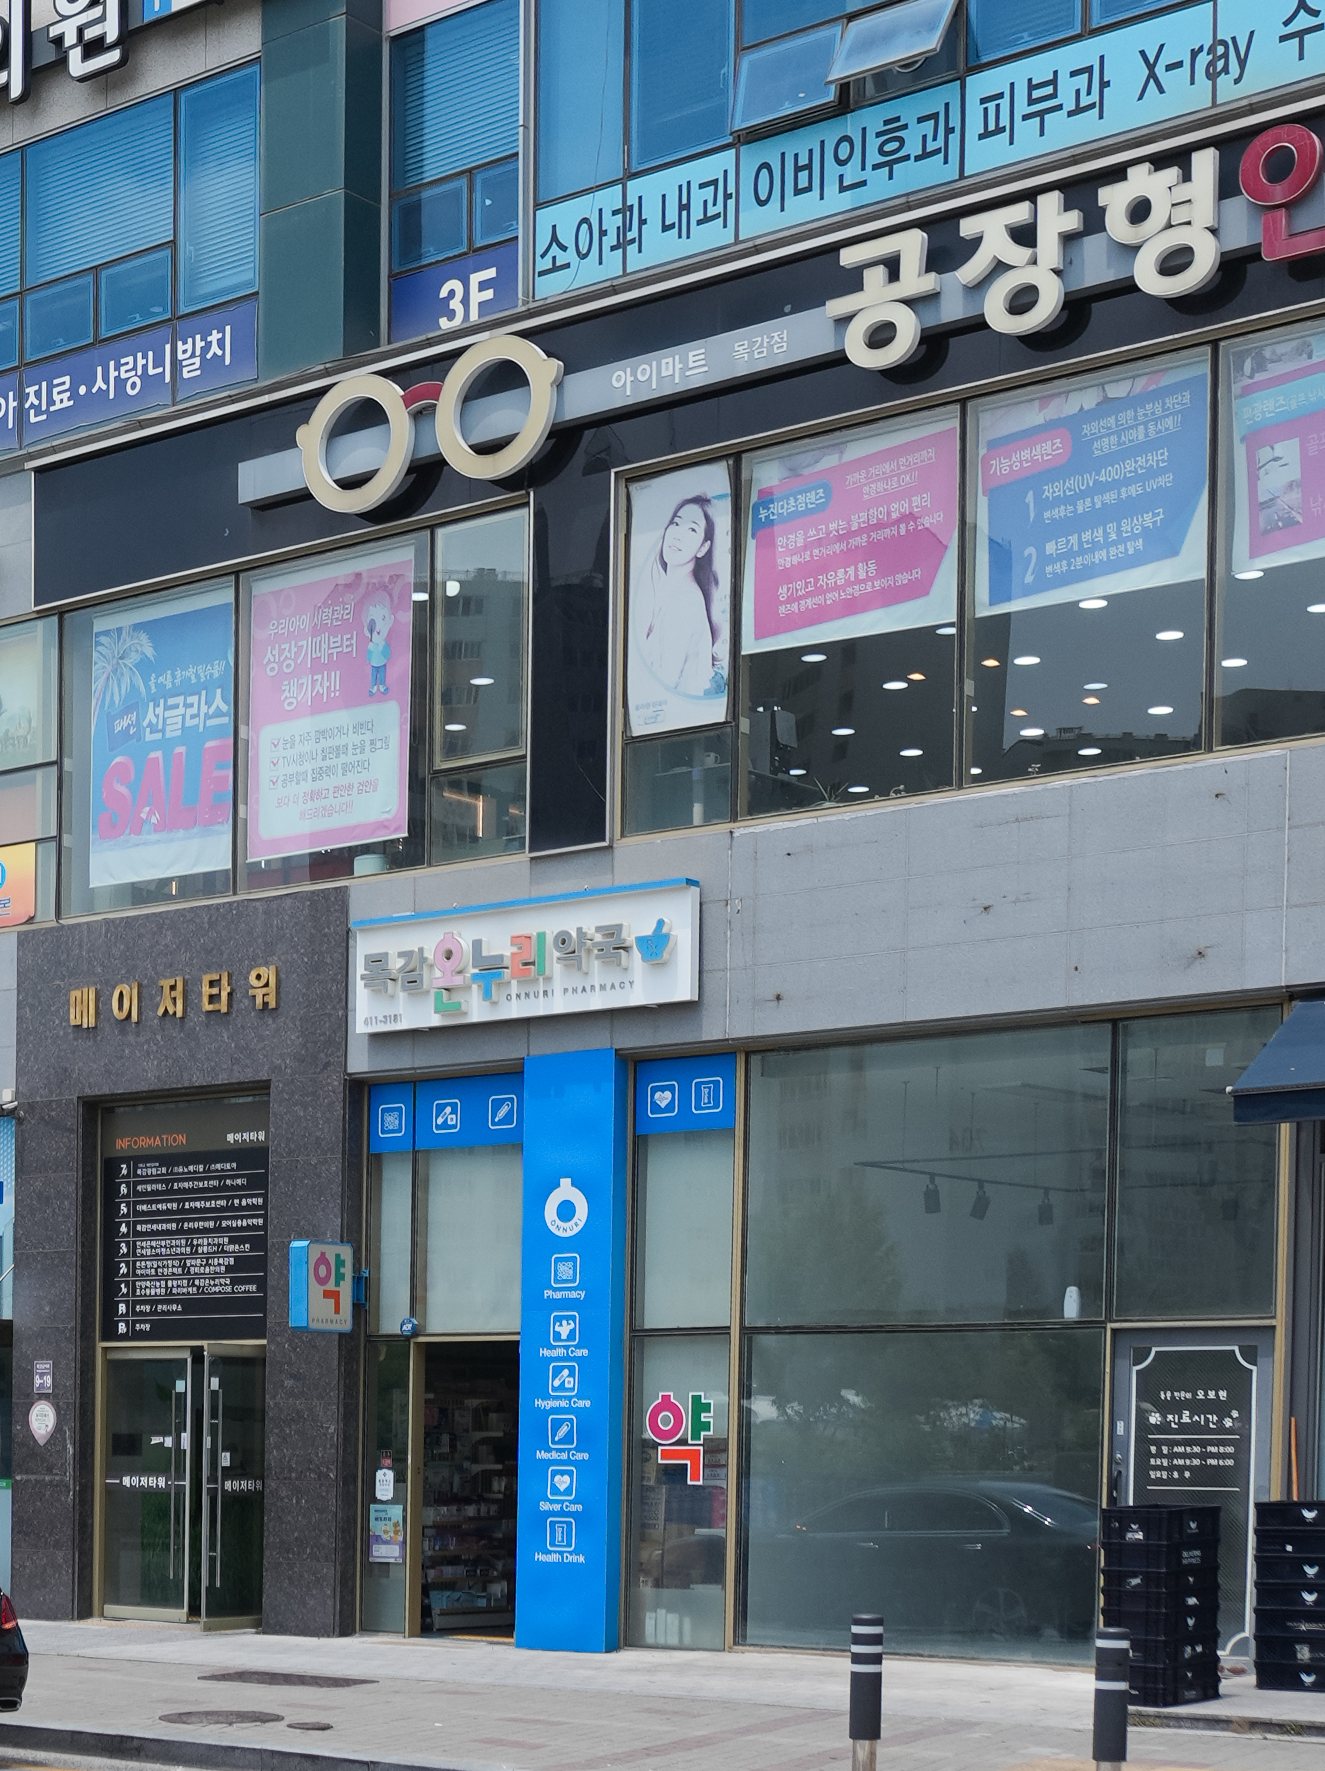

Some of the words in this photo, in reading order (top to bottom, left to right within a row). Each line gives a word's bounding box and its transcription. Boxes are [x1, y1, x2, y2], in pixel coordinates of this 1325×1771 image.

[536, 194, 648, 278] 소아과
[660, 168, 733, 234] 내과
[753, 100, 956, 213] 이비인후과
[977, 54, 1111, 147] 피부과
[1135, 29, 1255, 103] X-ray
[439, 266, 497, 331] 3F
[91, 324, 232, 401] 사랑니발치
[610, 347, 710, 397] 아이마트
[731, 327, 789, 363] 목감점
[267, 612, 311, 641] 우리아이
[311, 601, 355, 630] 시력관리
[263, 631, 357, 676] 성장기때부터
[280, 670, 341, 711] 챙기자!!
[142, 687, 231, 742] 선글라스
[98, 736, 233, 840] SALE
[69, 964, 280, 1029] 메이저타워
[505, 987, 556, 1003] ONNURI
[563, 978, 636, 998] PHARMACY
[115, 1133, 187, 1150] INFORMATION
[226, 1130, 266, 1144] 메이저타워
[549, 1216, 583, 1235] ONNURI
[234, 1283, 258, 1293] COFFEE
[313, 1250, 347, 1315] 약
[543, 1288, 586, 1301] Pharmacy
[539, 1346, 565, 1358] Health
[567, 1346, 589, 1357] Care
[35, 1374, 52, 1388] 9-19
[534, 1398, 570, 1411] Hygienic
[572, 1398, 591, 1408] Care
[1166, 1410, 1218, 1428] 진료시간
[646, 1391, 715, 1486] 약
[536, 1450, 569, 1461] Medical
[571, 1450, 589, 1461] Care
[122, 1476, 166, 1490] 메이저타워
[224, 1480, 263, 1493] 메이저타워
[539, 1501, 561, 1512] Silver
[563, 1502, 583, 1512] Care
[535, 1551, 561, 1563] Health
[563, 1552, 586, 1564] Drink
